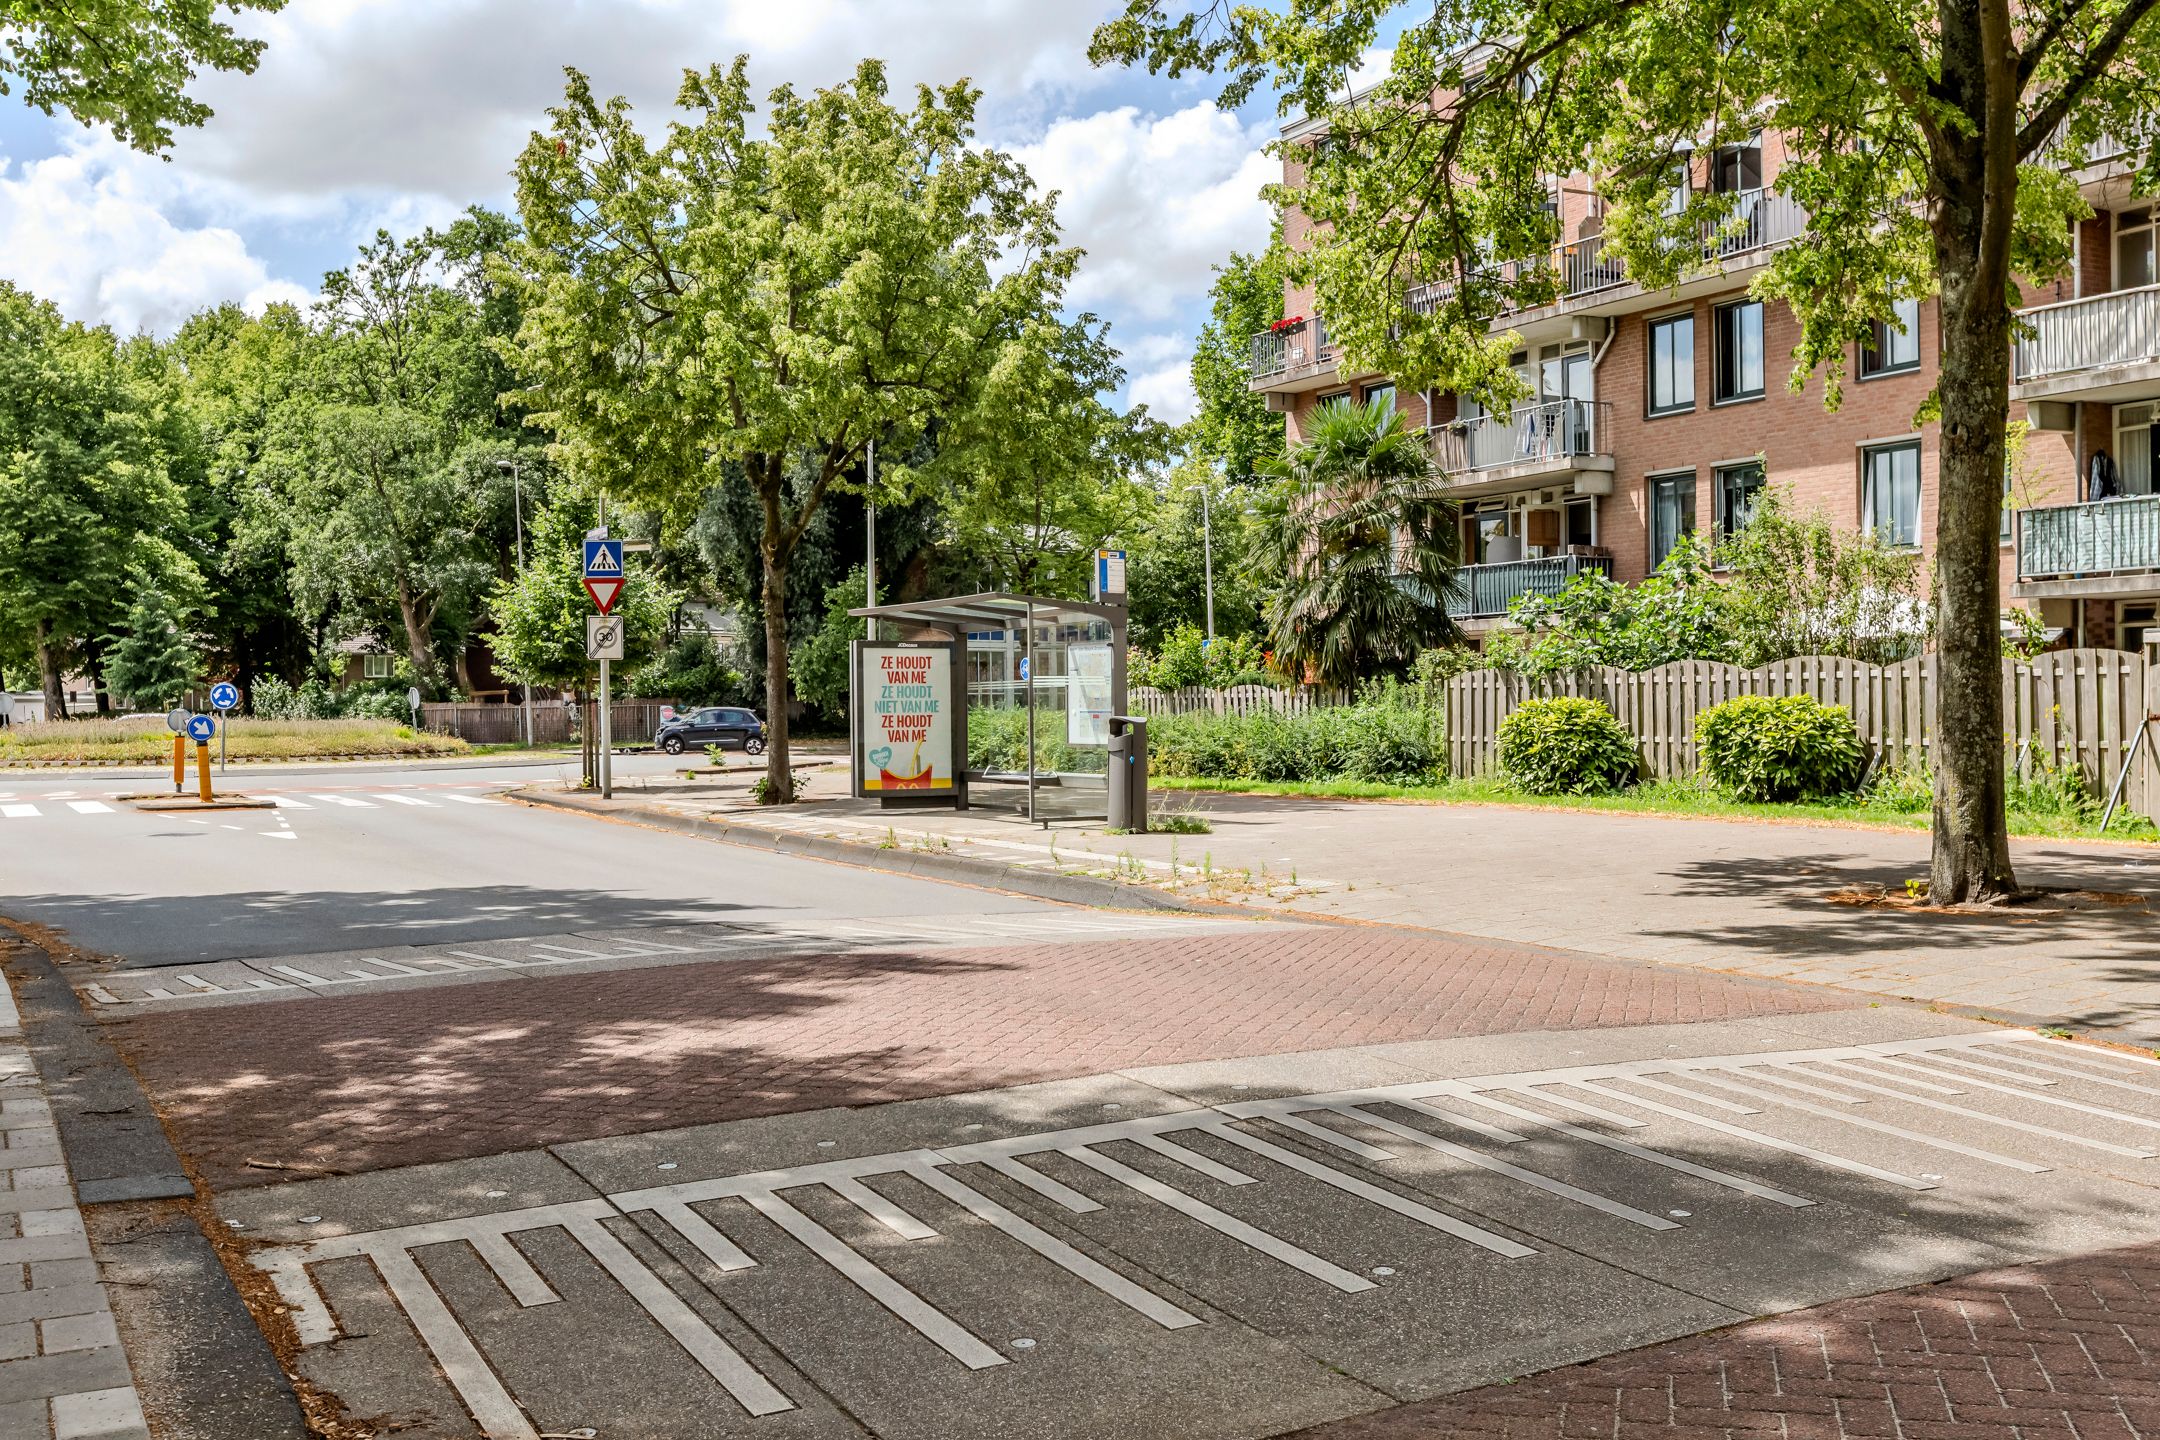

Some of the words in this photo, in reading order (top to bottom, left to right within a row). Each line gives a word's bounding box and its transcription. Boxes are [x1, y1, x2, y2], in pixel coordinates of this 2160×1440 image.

[598, 633, 613, 641] 30
[881, 656, 893, 669] ZE
[896, 656, 932, 669] HOUDT
[887, 671, 908, 684] VAN
[911, 671, 927, 684] ME
[881, 685, 893, 698] ZE
[896, 685, 932, 698] HOUDT
[875, 700, 897, 713] NIET
[901, 700, 922, 713] VAN
[924, 700, 939, 713] ME
[882, 715, 894, 728] ZE
[896, 715, 932, 728] HOUDT
[888, 730, 909, 743] VAN
[911, 730, 927, 742] ME
